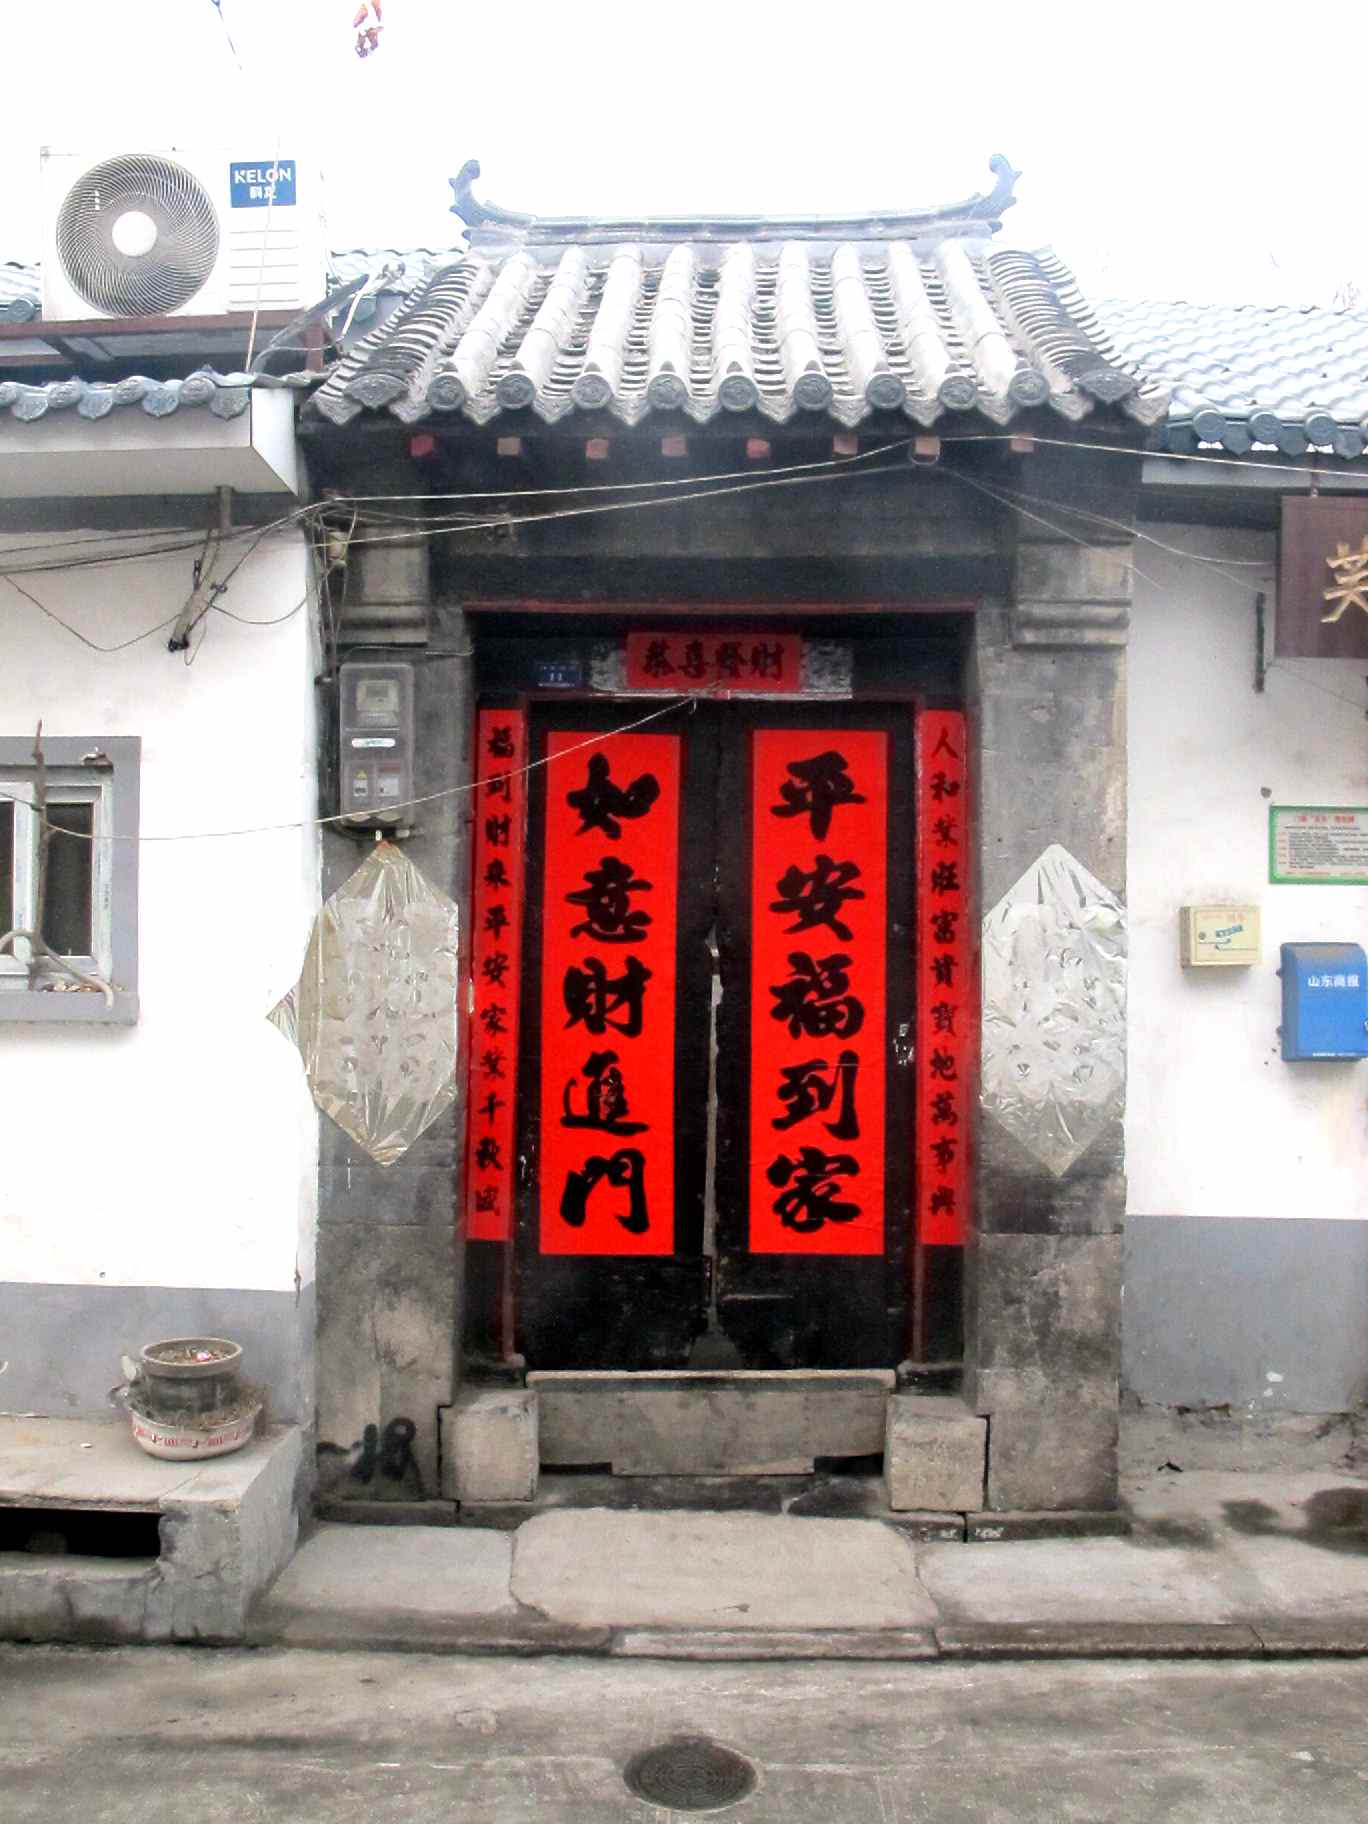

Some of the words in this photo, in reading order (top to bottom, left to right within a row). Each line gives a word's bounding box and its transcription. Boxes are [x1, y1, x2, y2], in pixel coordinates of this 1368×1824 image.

[234, 168, 292, 184] KELON
[560, 751, 661, 1234] 如意財進門
[766, 750, 867, 1232] 平安福到家
